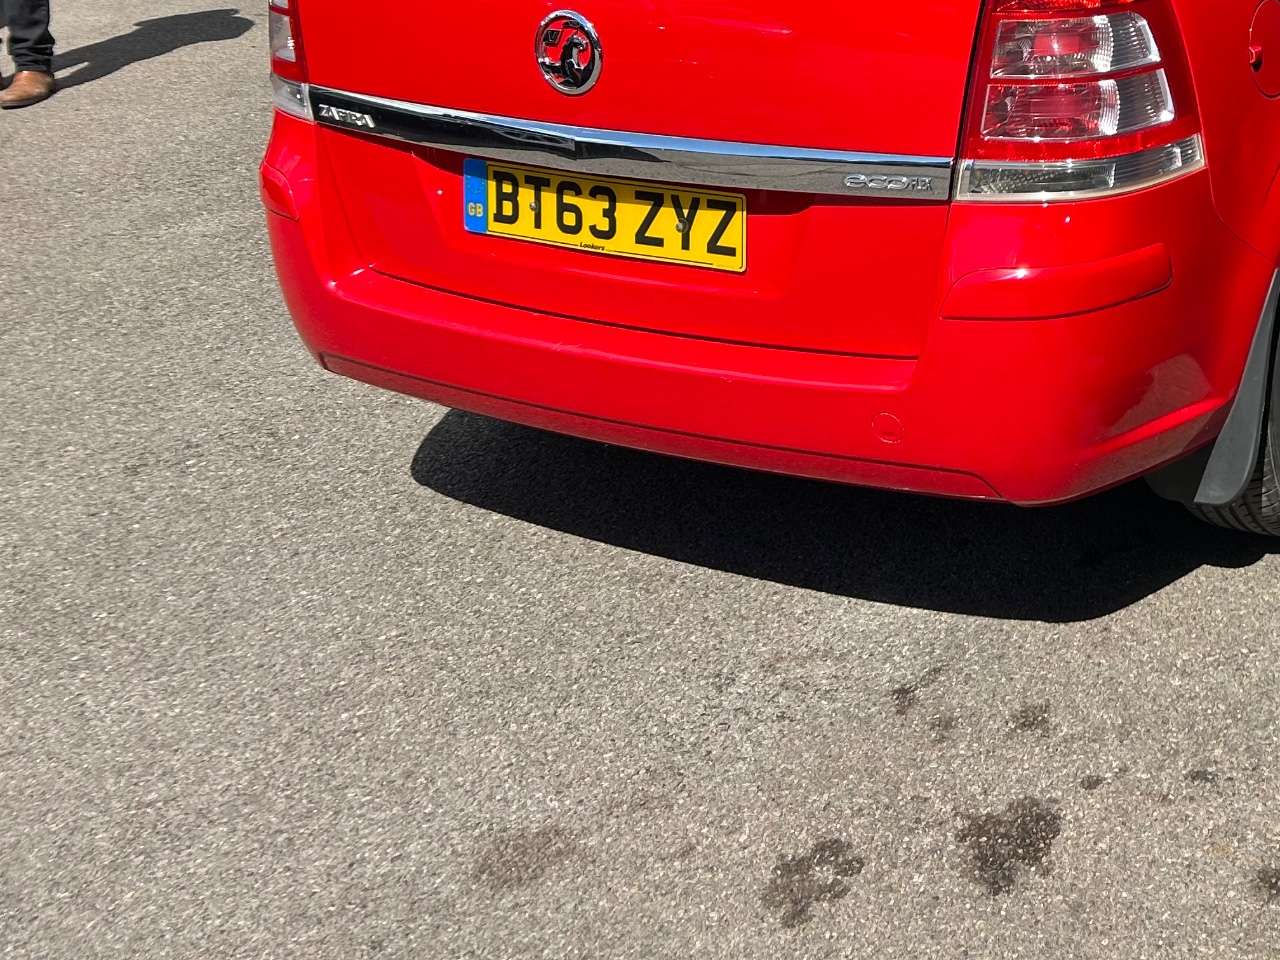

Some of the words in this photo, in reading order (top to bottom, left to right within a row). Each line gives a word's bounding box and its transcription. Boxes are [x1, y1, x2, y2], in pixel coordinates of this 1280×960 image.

[468, 202, 484, 217] GB
[492, 170, 617, 241] BT63
[634, 190, 738, 258] ZYZ
